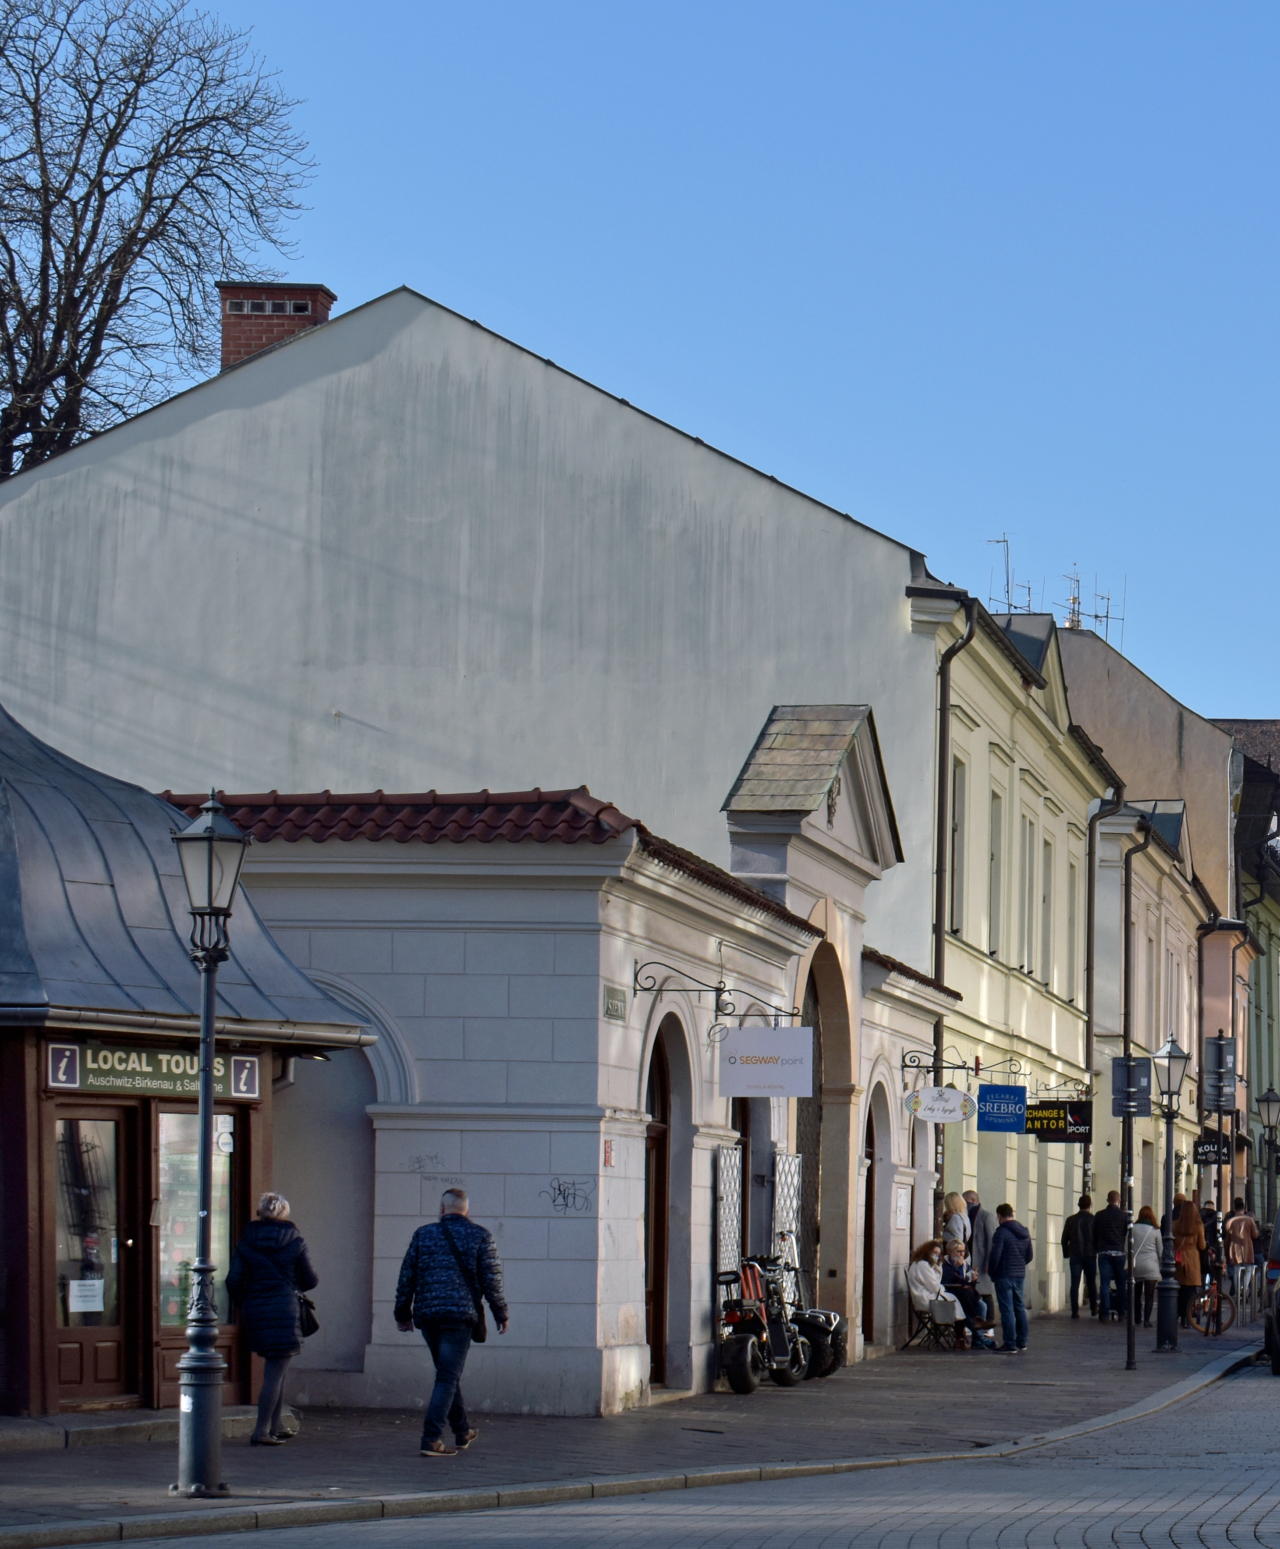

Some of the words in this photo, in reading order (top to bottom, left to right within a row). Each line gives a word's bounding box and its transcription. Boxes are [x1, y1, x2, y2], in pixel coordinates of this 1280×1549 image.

[86, 1050, 153, 1072] LOCAL
[158, 1054, 225, 1077] TOUS
[739, 1056, 780, 1065] SEGWAY
[780, 1057, 804, 1066] point
[87, 1074, 174, 1090] Auschwitz-Birkenau
[175, 1080, 183, 1091] &
[986, 1093, 1018, 1101] ZEGARKI
[979, 1102, 1024, 1114] SREBRO
[1025, 1109, 1059, 1118] CHANGE
[985, 1115, 1017, 1123] UPOMINKI
[1026, 1120, 1065, 1129] ANTOR
[1197, 1144, 1228, 1154] KOLIA
